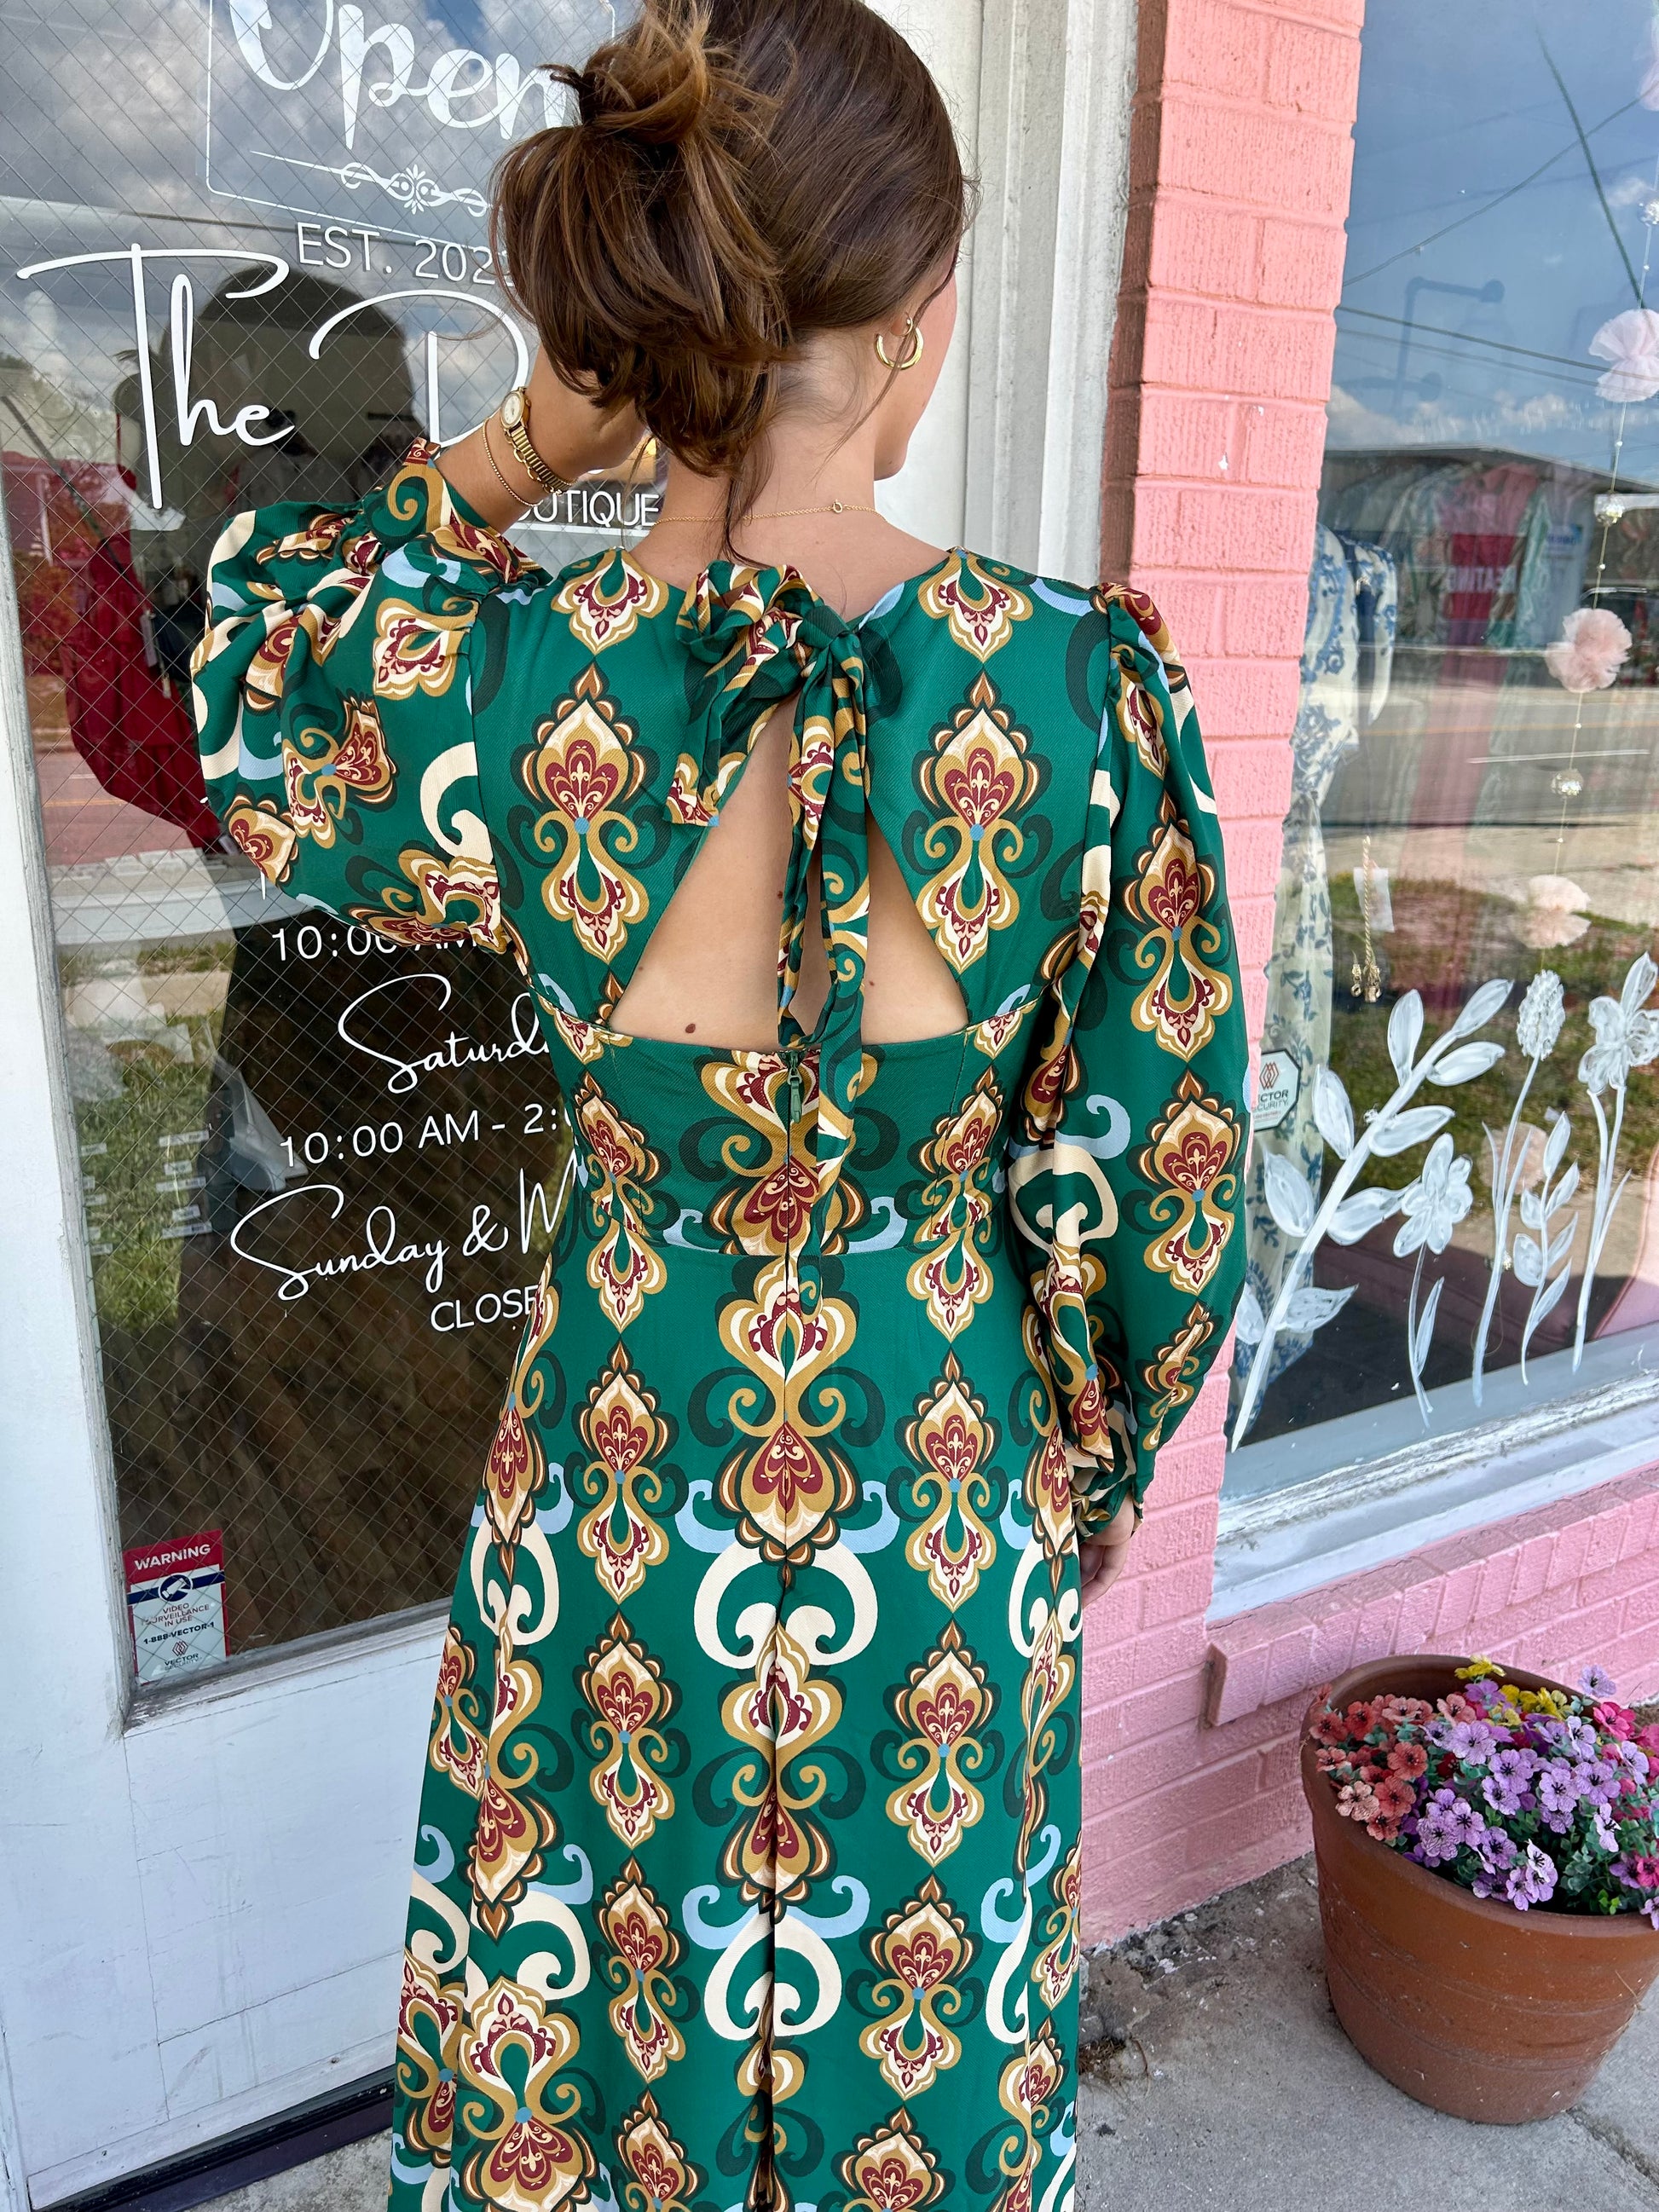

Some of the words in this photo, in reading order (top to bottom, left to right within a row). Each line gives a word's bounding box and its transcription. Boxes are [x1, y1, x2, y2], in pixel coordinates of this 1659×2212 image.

[229, 0, 583, 150] Open
[298, 222, 393, 274] EST.
[414, 239, 514, 287] 202
[17, 243, 295, 510] The
[518, 489, 660, 528] UTIQUE
[338, 973, 550, 1094] Saturd
[280, 1121, 404, 1168] 10:00
[418, 1111, 479, 1149] AM
[230, 1184, 450, 1301] Sunday
[462, 1204, 509, 1257] &
[431, 1285, 539, 1332] CLOSE
[134, 1544, 211, 1571] WARNING
[145, 1604, 210, 1626] SURVEILLANCE
[163, 1603, 189, 1614] VIDEO
[176, 1615, 193, 1625] USE
[143, 1621, 215, 1645] 1-888-VECTOR-1
[164, 1653, 199, 1666] VECTOR
